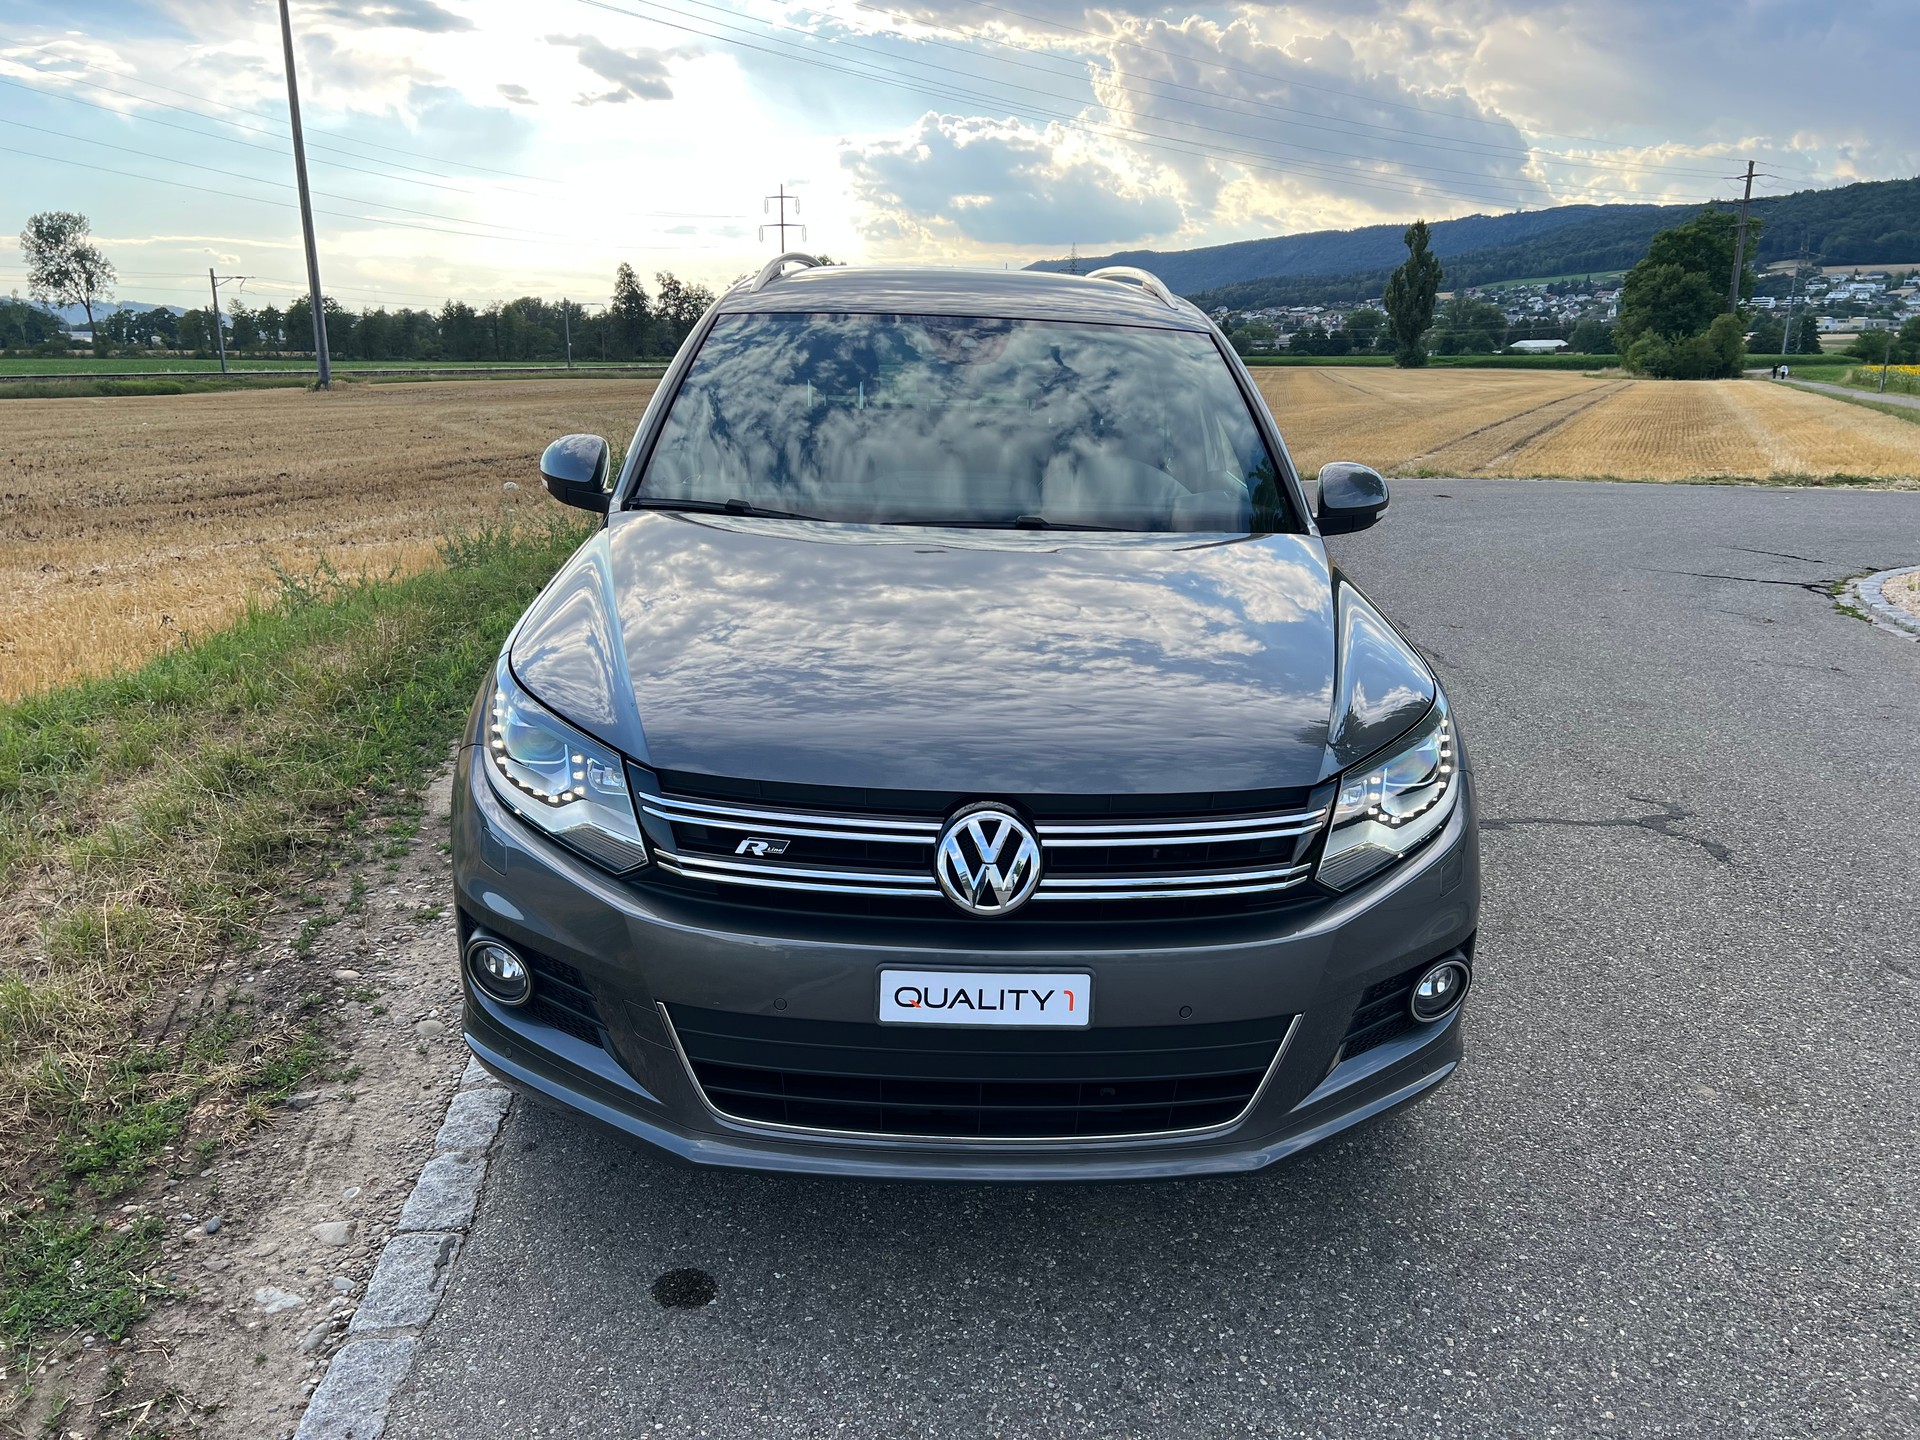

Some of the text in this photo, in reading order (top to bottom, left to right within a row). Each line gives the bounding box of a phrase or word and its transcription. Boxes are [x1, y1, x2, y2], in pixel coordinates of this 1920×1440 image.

[734, 840, 769, 856] R
[943, 816, 1035, 909] VW
[894, 986, 1055, 1011] QUALITY
